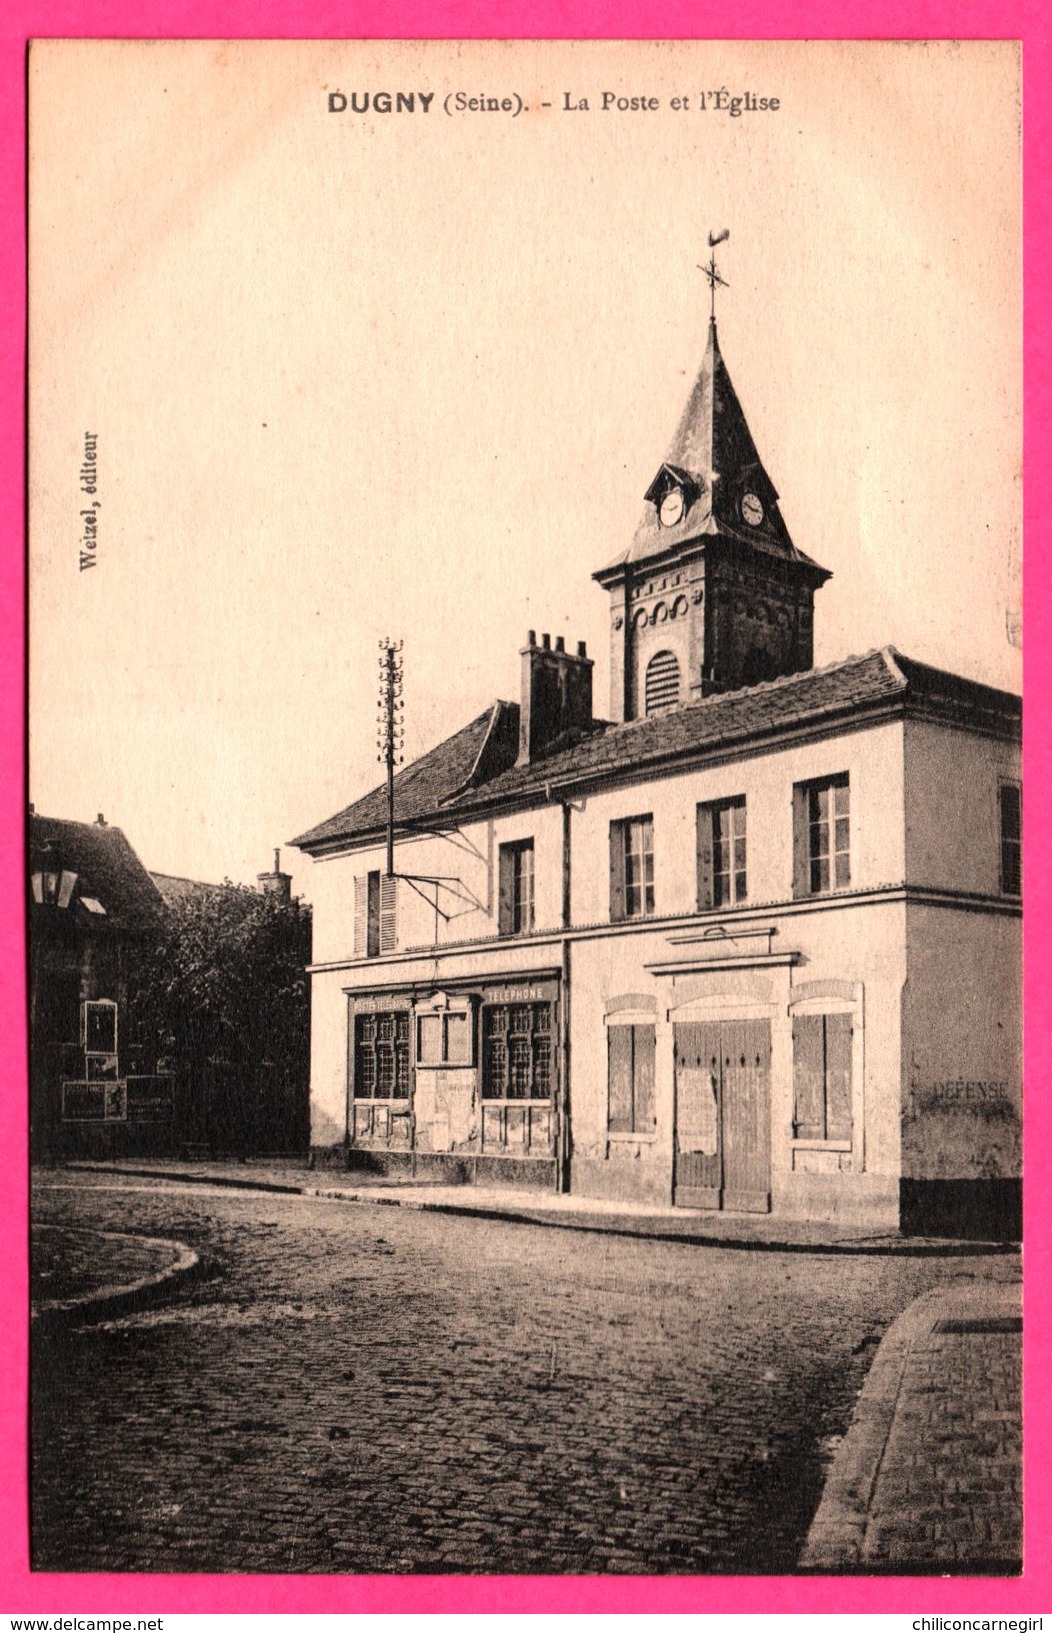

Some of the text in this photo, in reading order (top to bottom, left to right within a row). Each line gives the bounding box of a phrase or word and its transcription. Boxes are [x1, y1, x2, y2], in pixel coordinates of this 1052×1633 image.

[328, 91, 435, 114] DUGNY
[443, 92, 529, 118] (Seine).
[563, 92, 590, 111] La
[601, 91, 660, 111] Poste
[670, 96, 690, 111] et
[79, 431, 98, 495] éditeur
